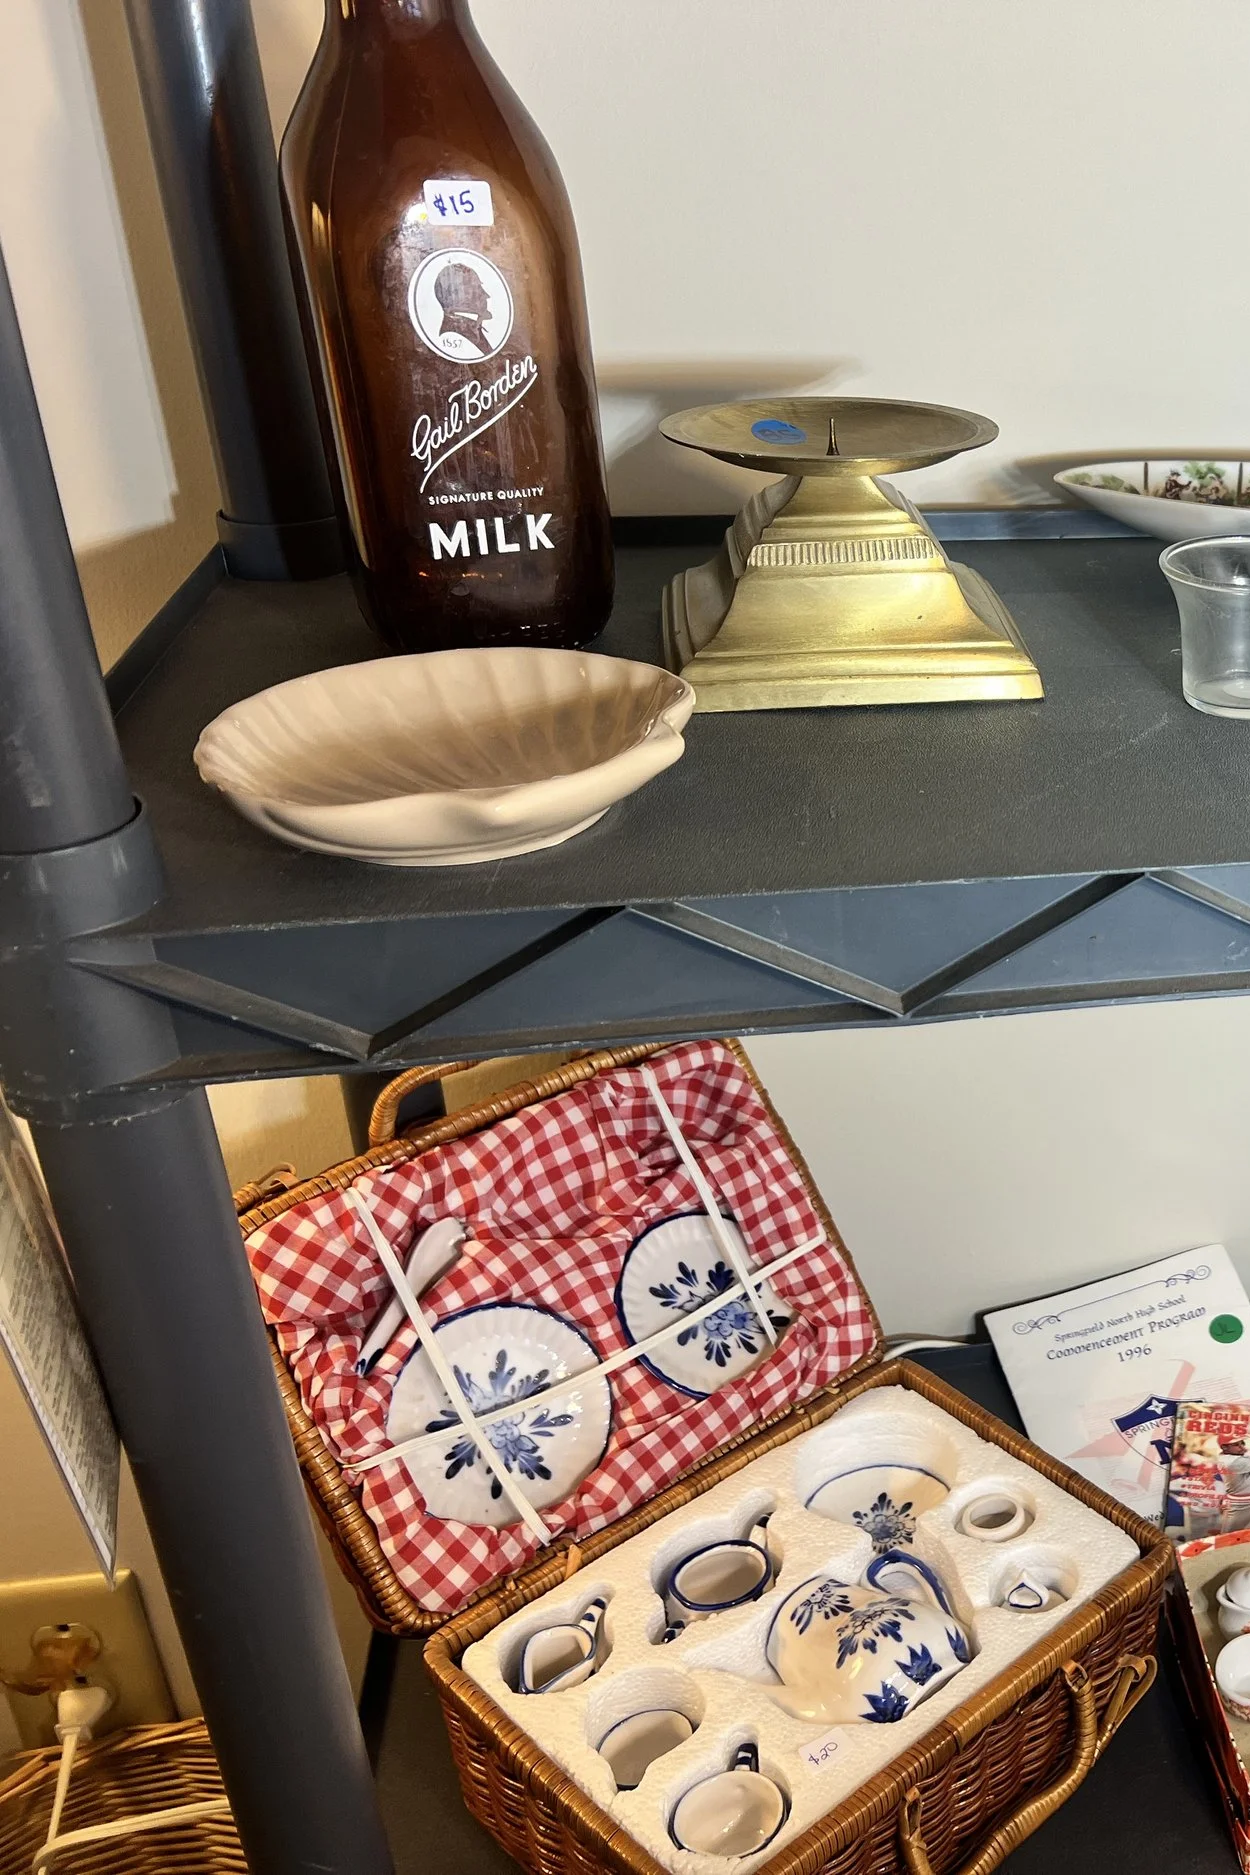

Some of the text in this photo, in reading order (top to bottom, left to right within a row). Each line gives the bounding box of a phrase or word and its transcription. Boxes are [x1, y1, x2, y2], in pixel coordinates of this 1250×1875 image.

[433, 190, 475, 217] $15
[410, 355, 538, 472] Gail Borden
[428, 486, 545, 506] SIGNATURE QUALITY
[428, 512, 556, 561] MILK
[1054, 1295, 1187, 1343] Springfield North High School
[1046, 1306, 1206, 1361] Commencement Program
[1117, 1344, 1153, 1362] 1996
[1186, 1420, 1248, 1435] REDS
[808, 1741, 839, 1766] $20
